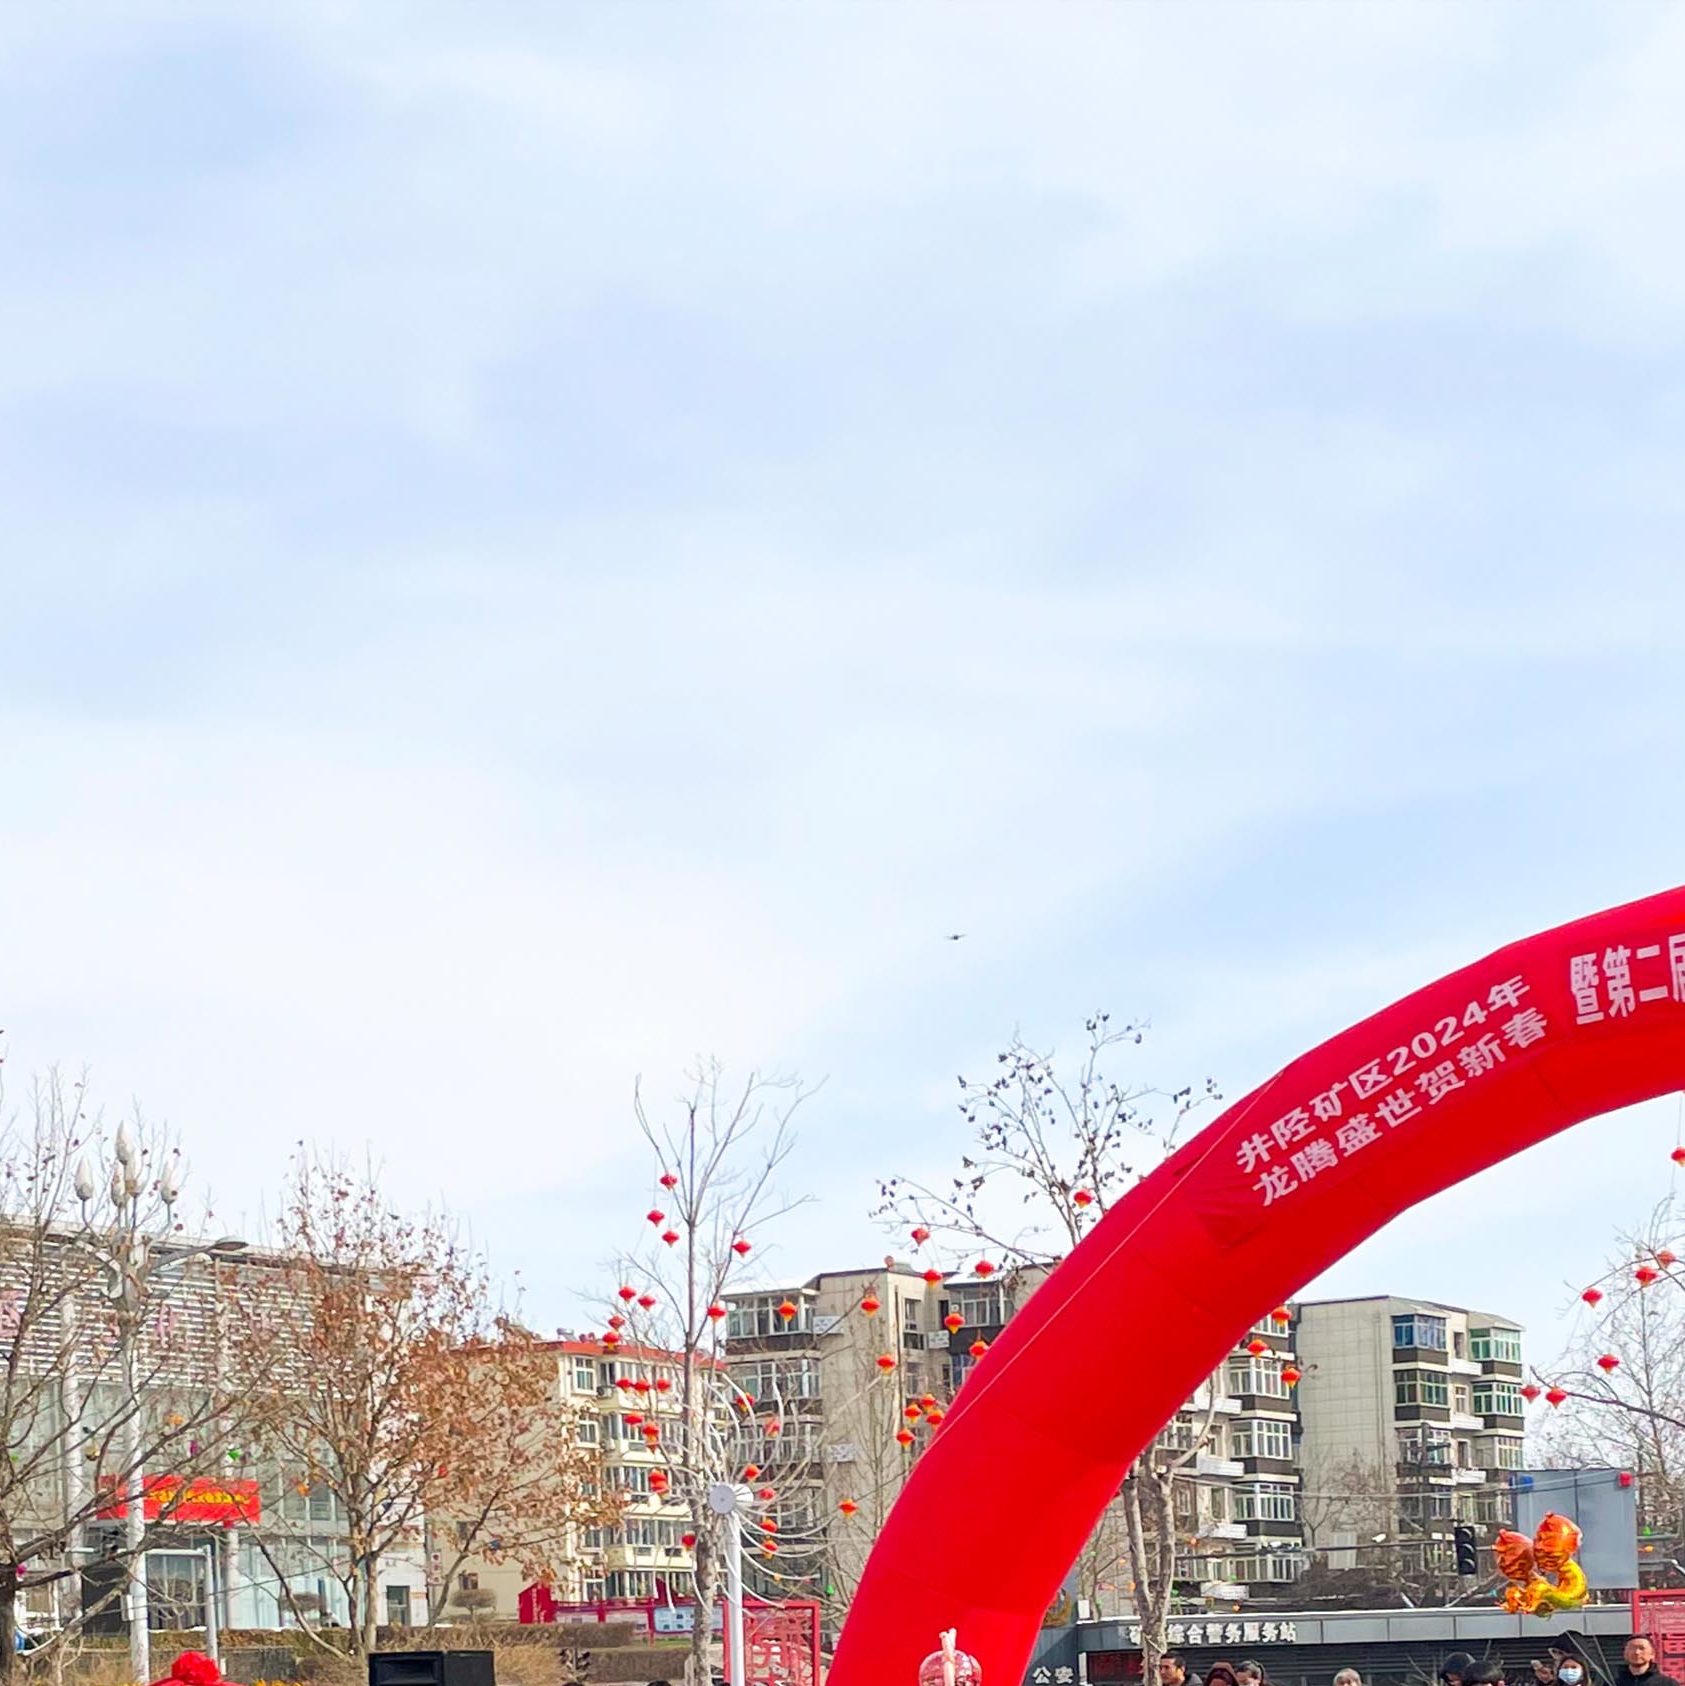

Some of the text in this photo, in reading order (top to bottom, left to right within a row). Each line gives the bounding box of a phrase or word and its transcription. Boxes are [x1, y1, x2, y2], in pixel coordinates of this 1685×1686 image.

[1236, 974, 1531, 1172] 井陉矿区2024年
[1251, 1005, 1548, 1207] 龙腾盛世贺新春
[1032, 1666, 1074, 1685] 公安
[1128, 1622, 1297, 1645] 矿综合警务服务站
